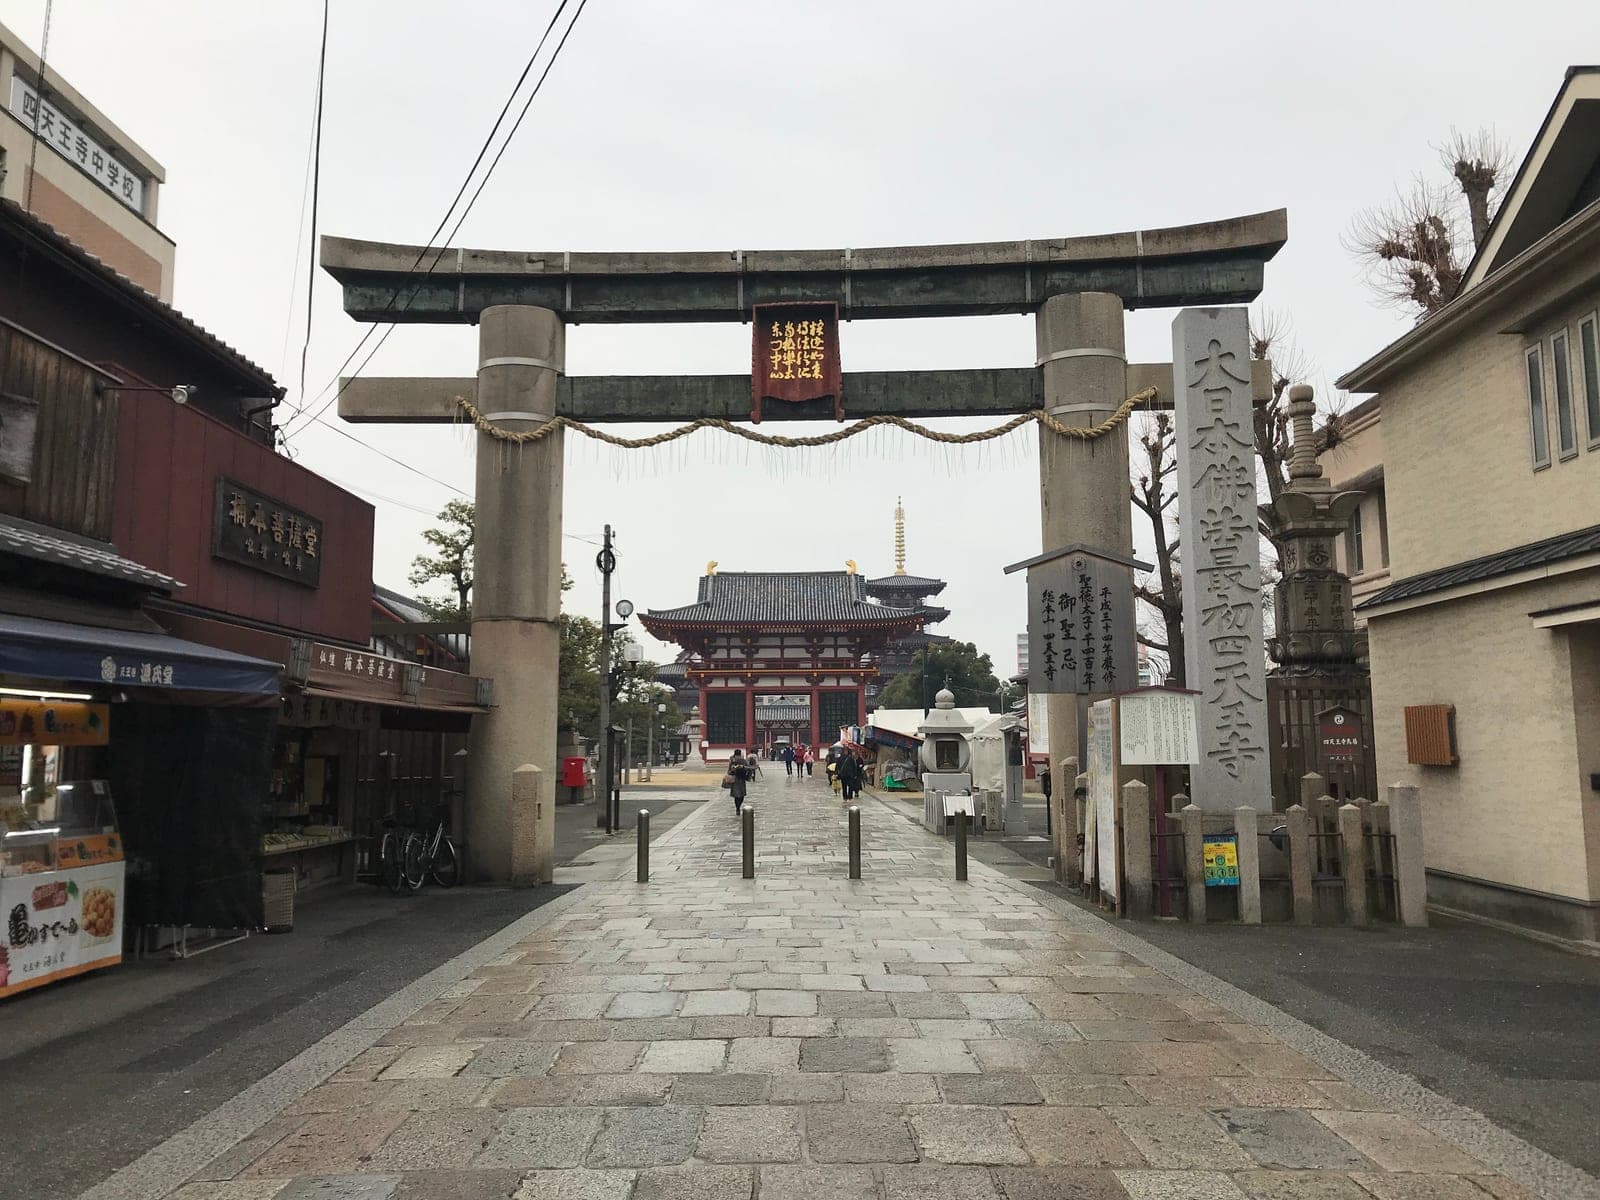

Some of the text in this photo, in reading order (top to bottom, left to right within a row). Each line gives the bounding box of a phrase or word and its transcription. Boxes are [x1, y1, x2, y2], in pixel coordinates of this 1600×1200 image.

[23, 91, 134, 202] 四天王寺中学校
[1058, 592, 1078, 671] 御聖忌
